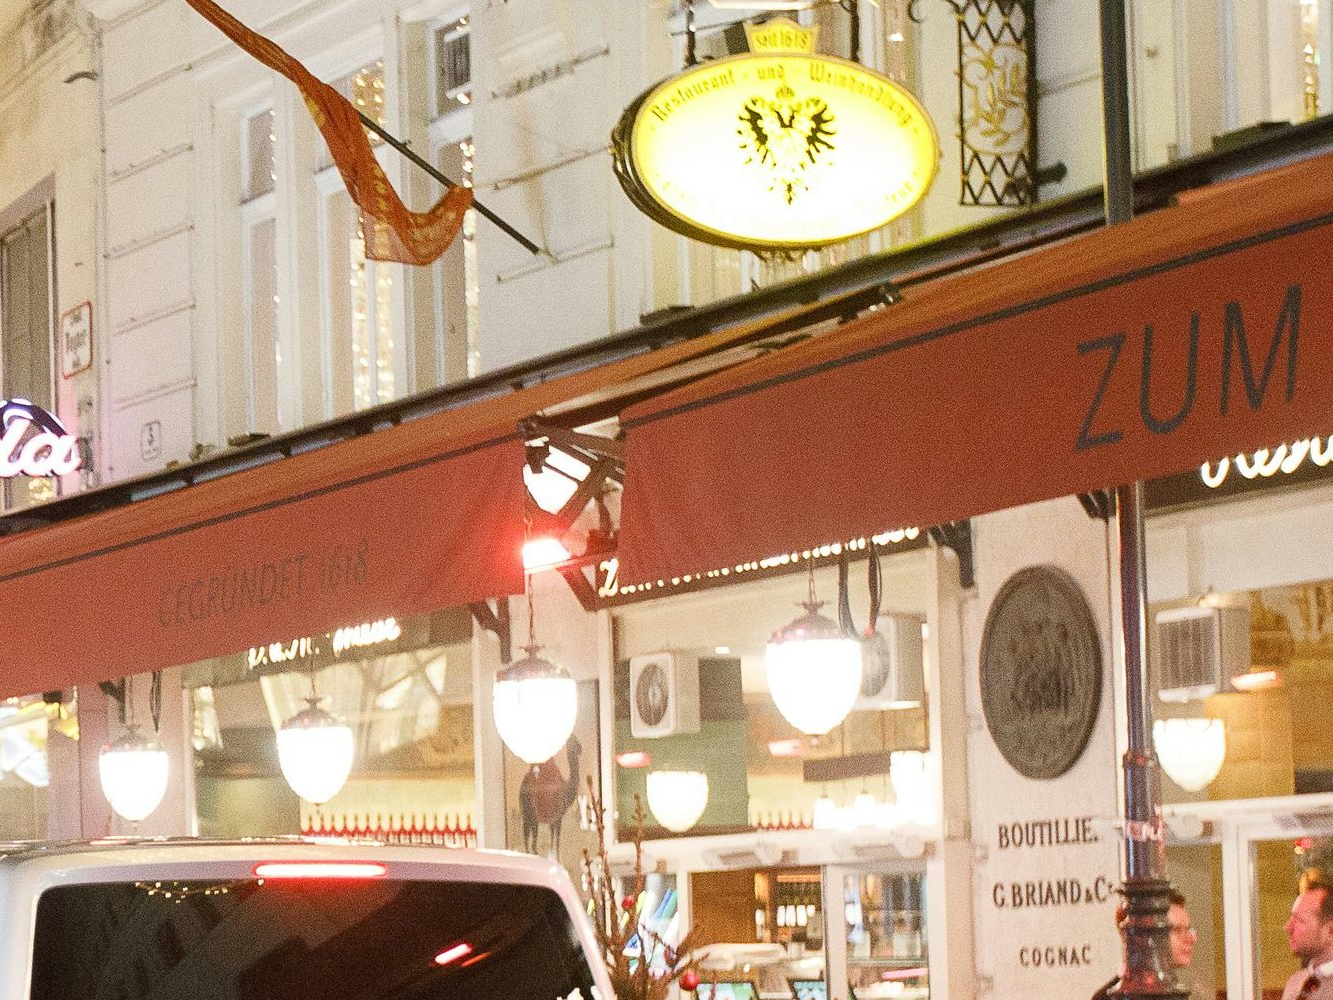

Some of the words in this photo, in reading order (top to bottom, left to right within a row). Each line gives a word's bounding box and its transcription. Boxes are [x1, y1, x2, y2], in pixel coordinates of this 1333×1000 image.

[756, 64, 784, 80] und
[1074, 284, 1302, 452] ZUM
[1019, 946, 1092, 967] COGNAC
